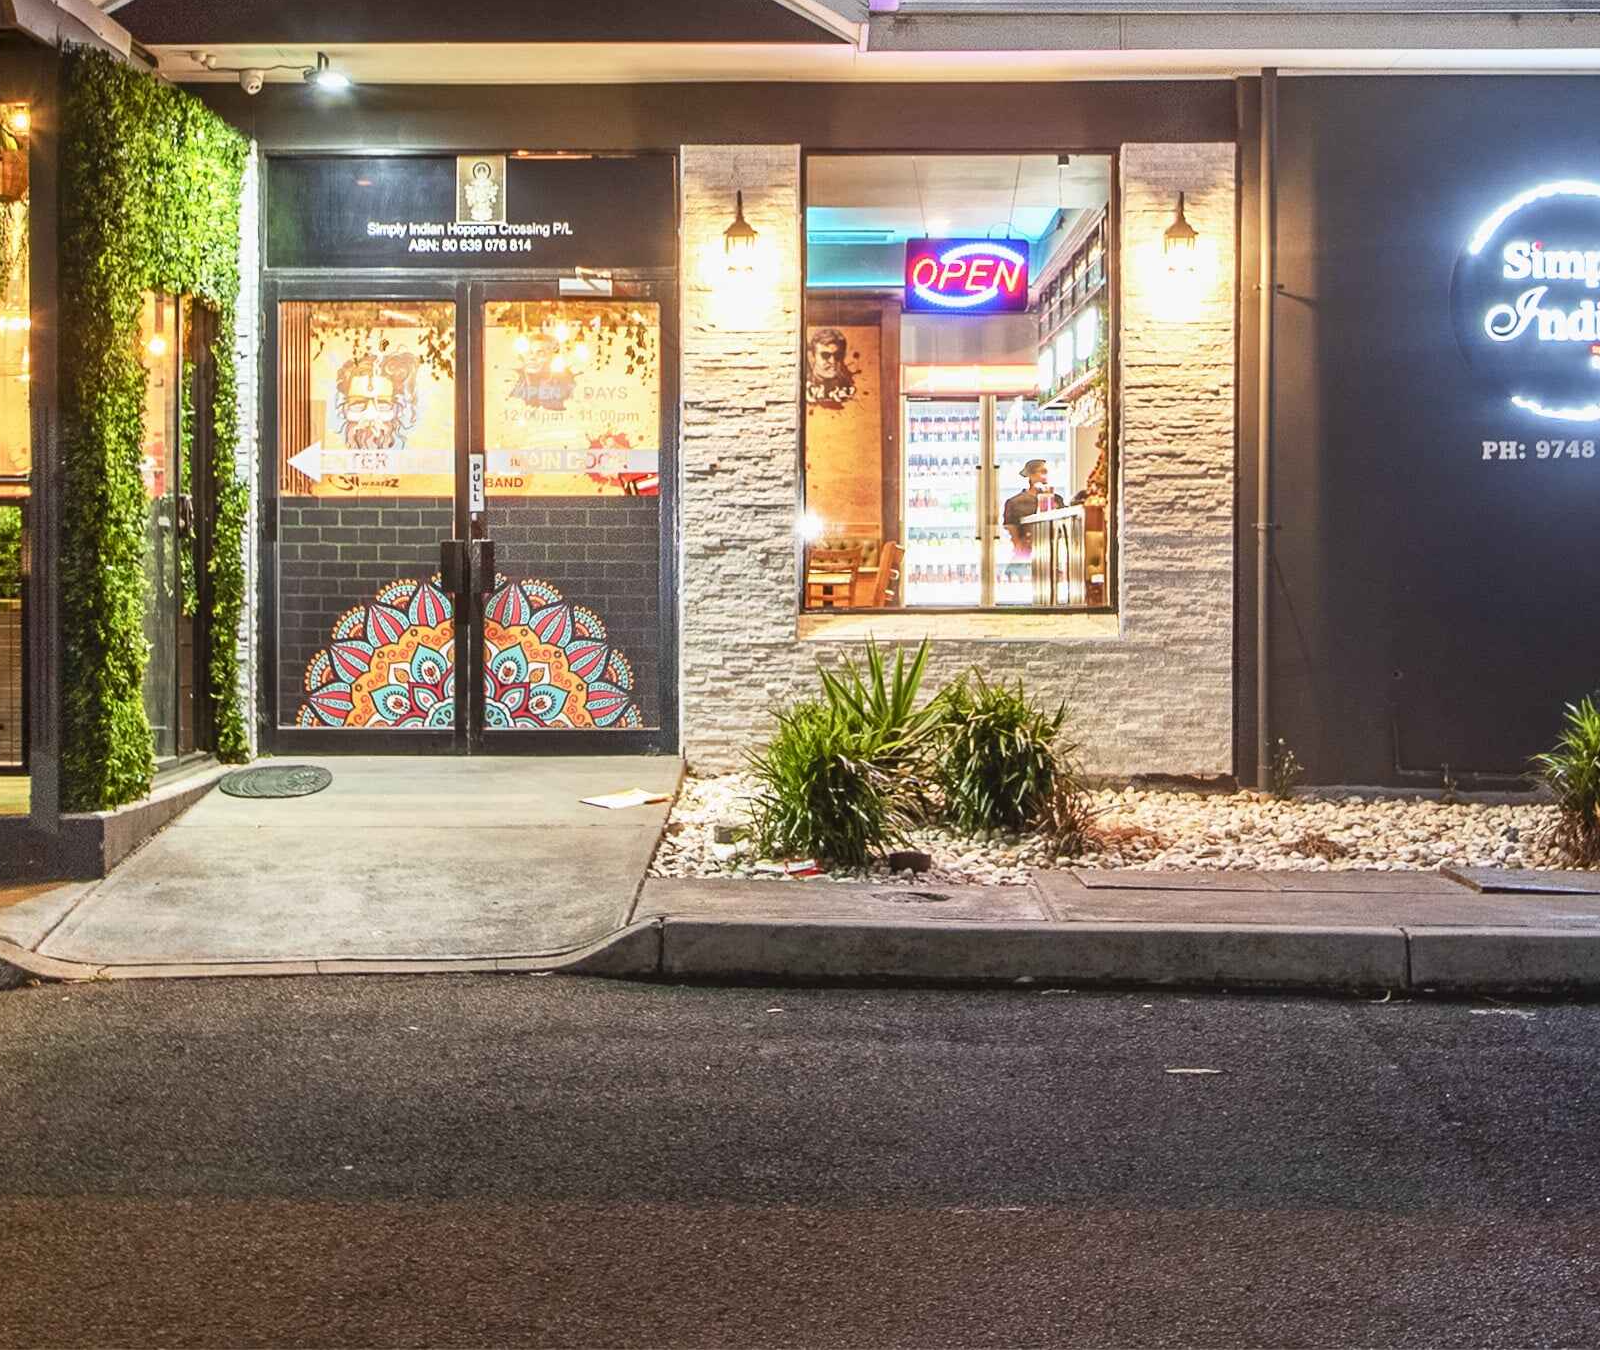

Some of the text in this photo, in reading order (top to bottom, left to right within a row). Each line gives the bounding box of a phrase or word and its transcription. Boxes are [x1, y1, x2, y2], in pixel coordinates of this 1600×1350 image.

[367, 222, 573, 238] Simply Indian Hoppers Crossing P/L
[408, 239, 532, 251] ABN: 80 639 076 814
[912, 257, 1020, 292] OPEN
[583, 386, 628, 400] DAYS
[1481, 441, 1526, 460] PH:
[1535, 440, 1595, 459] 9748
[472, 463, 482, 503] PULL
